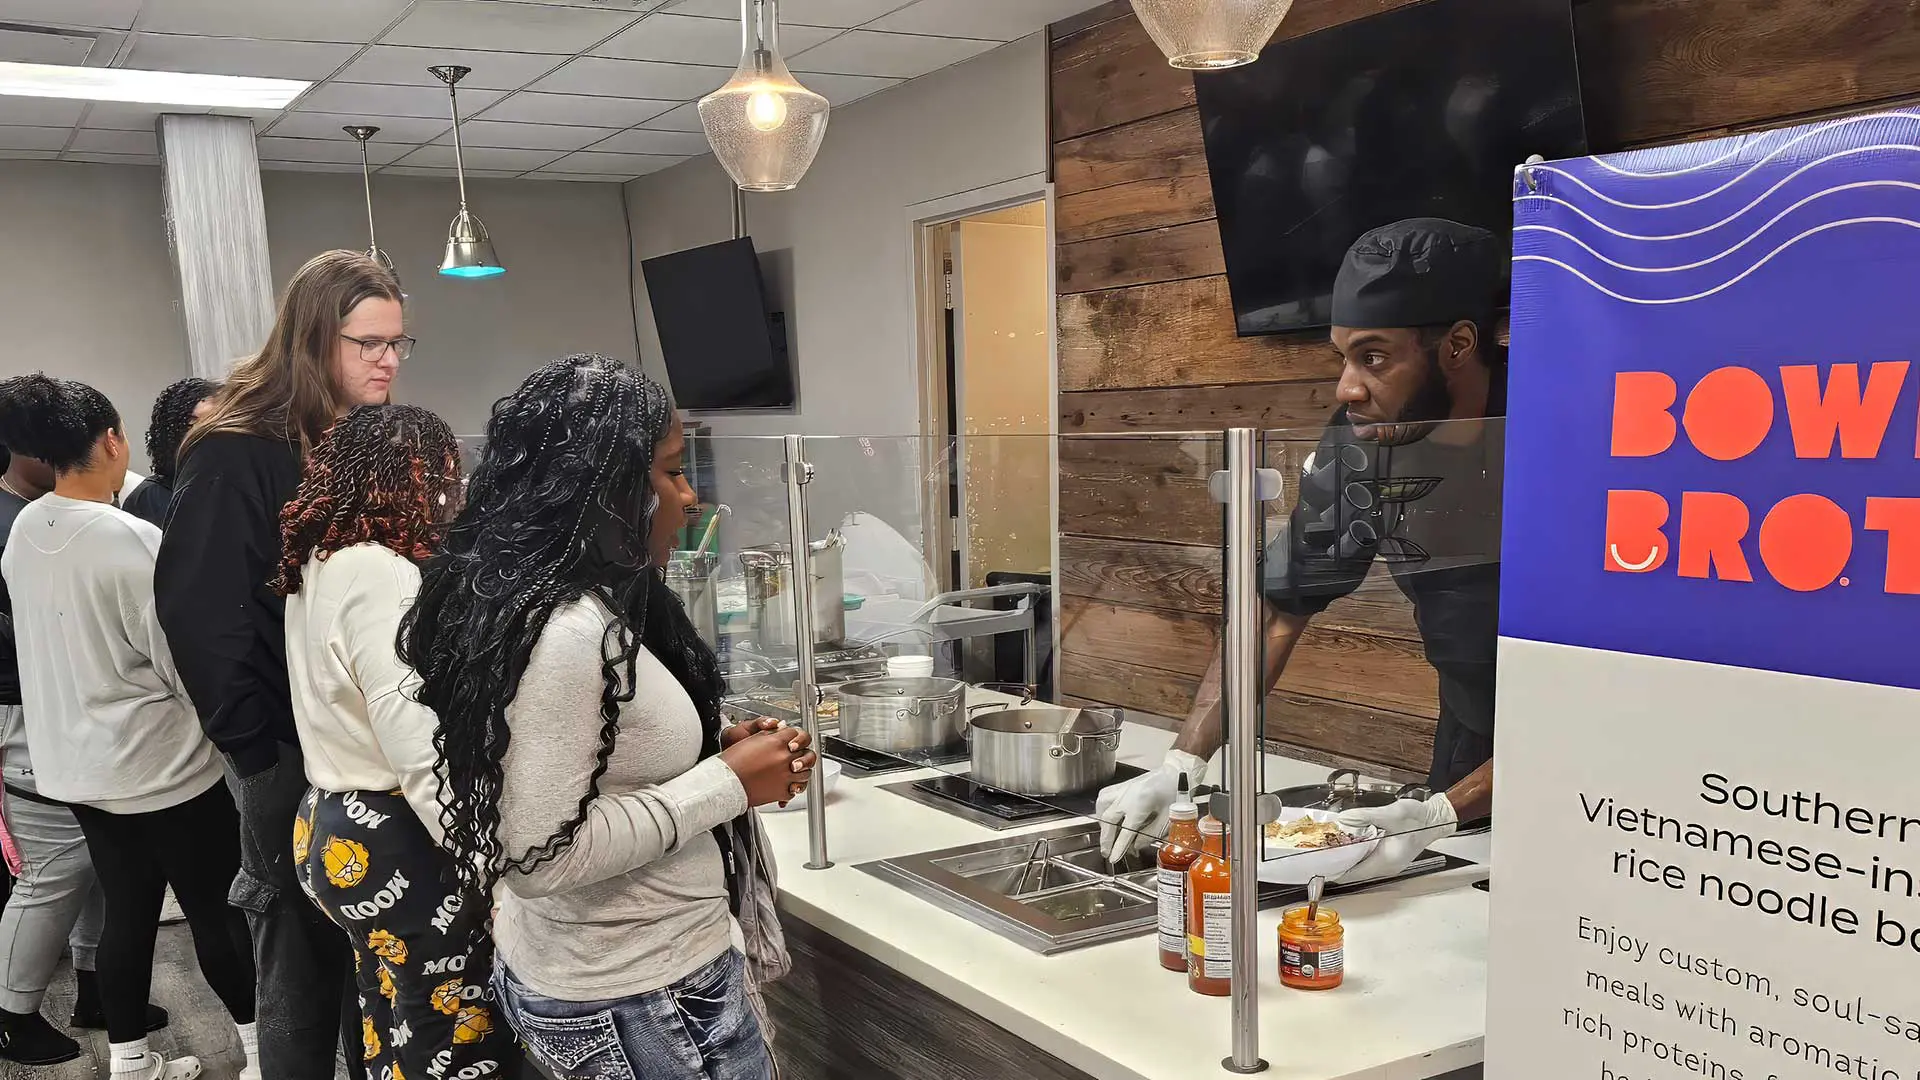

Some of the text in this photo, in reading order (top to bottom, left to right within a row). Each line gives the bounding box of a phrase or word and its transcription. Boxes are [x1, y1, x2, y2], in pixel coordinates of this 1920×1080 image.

[1611, 362, 1920, 461] BOW
[1579, 793, 1920, 898] Vietnamese-in
[340, 869, 410, 920] MOOD
[1613, 848, 1686, 890] rice
[1699, 873, 1859, 935] noodle
[1578, 916, 1649, 963] Enjoy
[1658, 947, 1779, 1002] custom,
[1563, 1008, 1612, 1041] rich
[1586, 970, 1665, 1011] meals
[1675, 999, 1736, 1036] with
